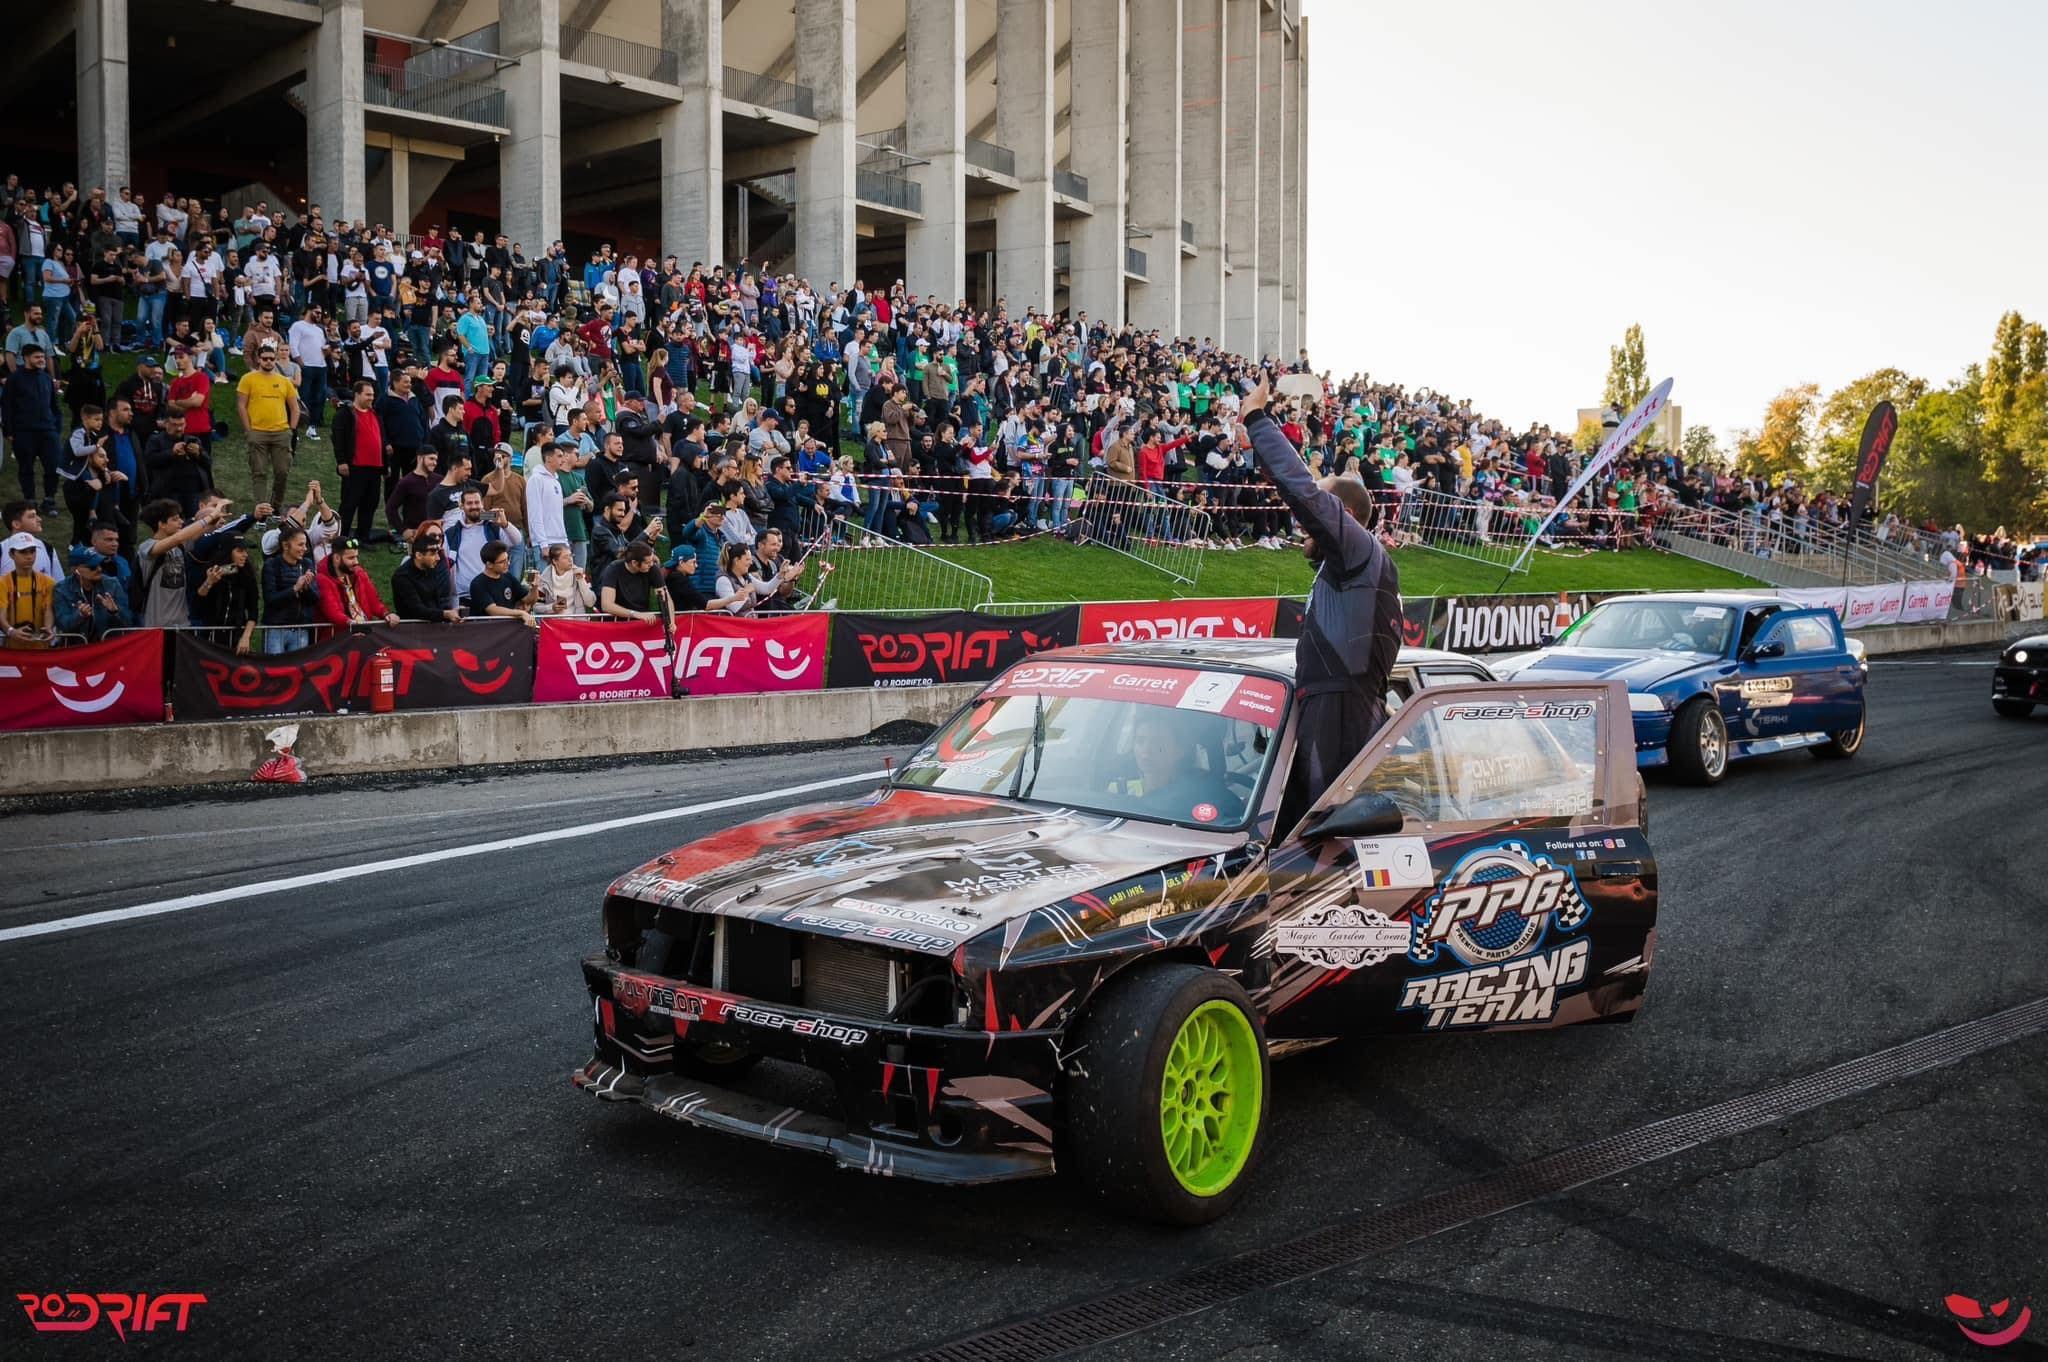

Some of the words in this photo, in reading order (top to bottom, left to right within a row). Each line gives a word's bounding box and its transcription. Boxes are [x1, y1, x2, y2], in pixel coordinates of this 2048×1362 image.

[1112, 673, 1178, 691] Garrett
[1208, 682, 1219, 692] 7
[599, 689, 651, 700] RODRIFT.RO
[1444, 702, 1593, 721] race-shop
[1545, 841, 1574, 850] Follow
[1589, 839, 1604, 848] on:
[1404, 854, 1413, 867] 7
[943, 863, 1095, 889] MASTER
[1427, 871, 1566, 942] PPG
[782, 912, 956, 950] race-shop
[1286, 930, 1317, 944] Magic
[1328, 930, 1365, 941] Garden
[1455, 927, 1483, 956] PREMIUM
[1486, 949, 1511, 959] PARTS
[1513, 921, 1537, 951] GARAGE
[1401, 940, 1589, 1008] RACING
[1427, 986, 1556, 1028] TEAM
[719, 1003, 868, 1045] race-shop
